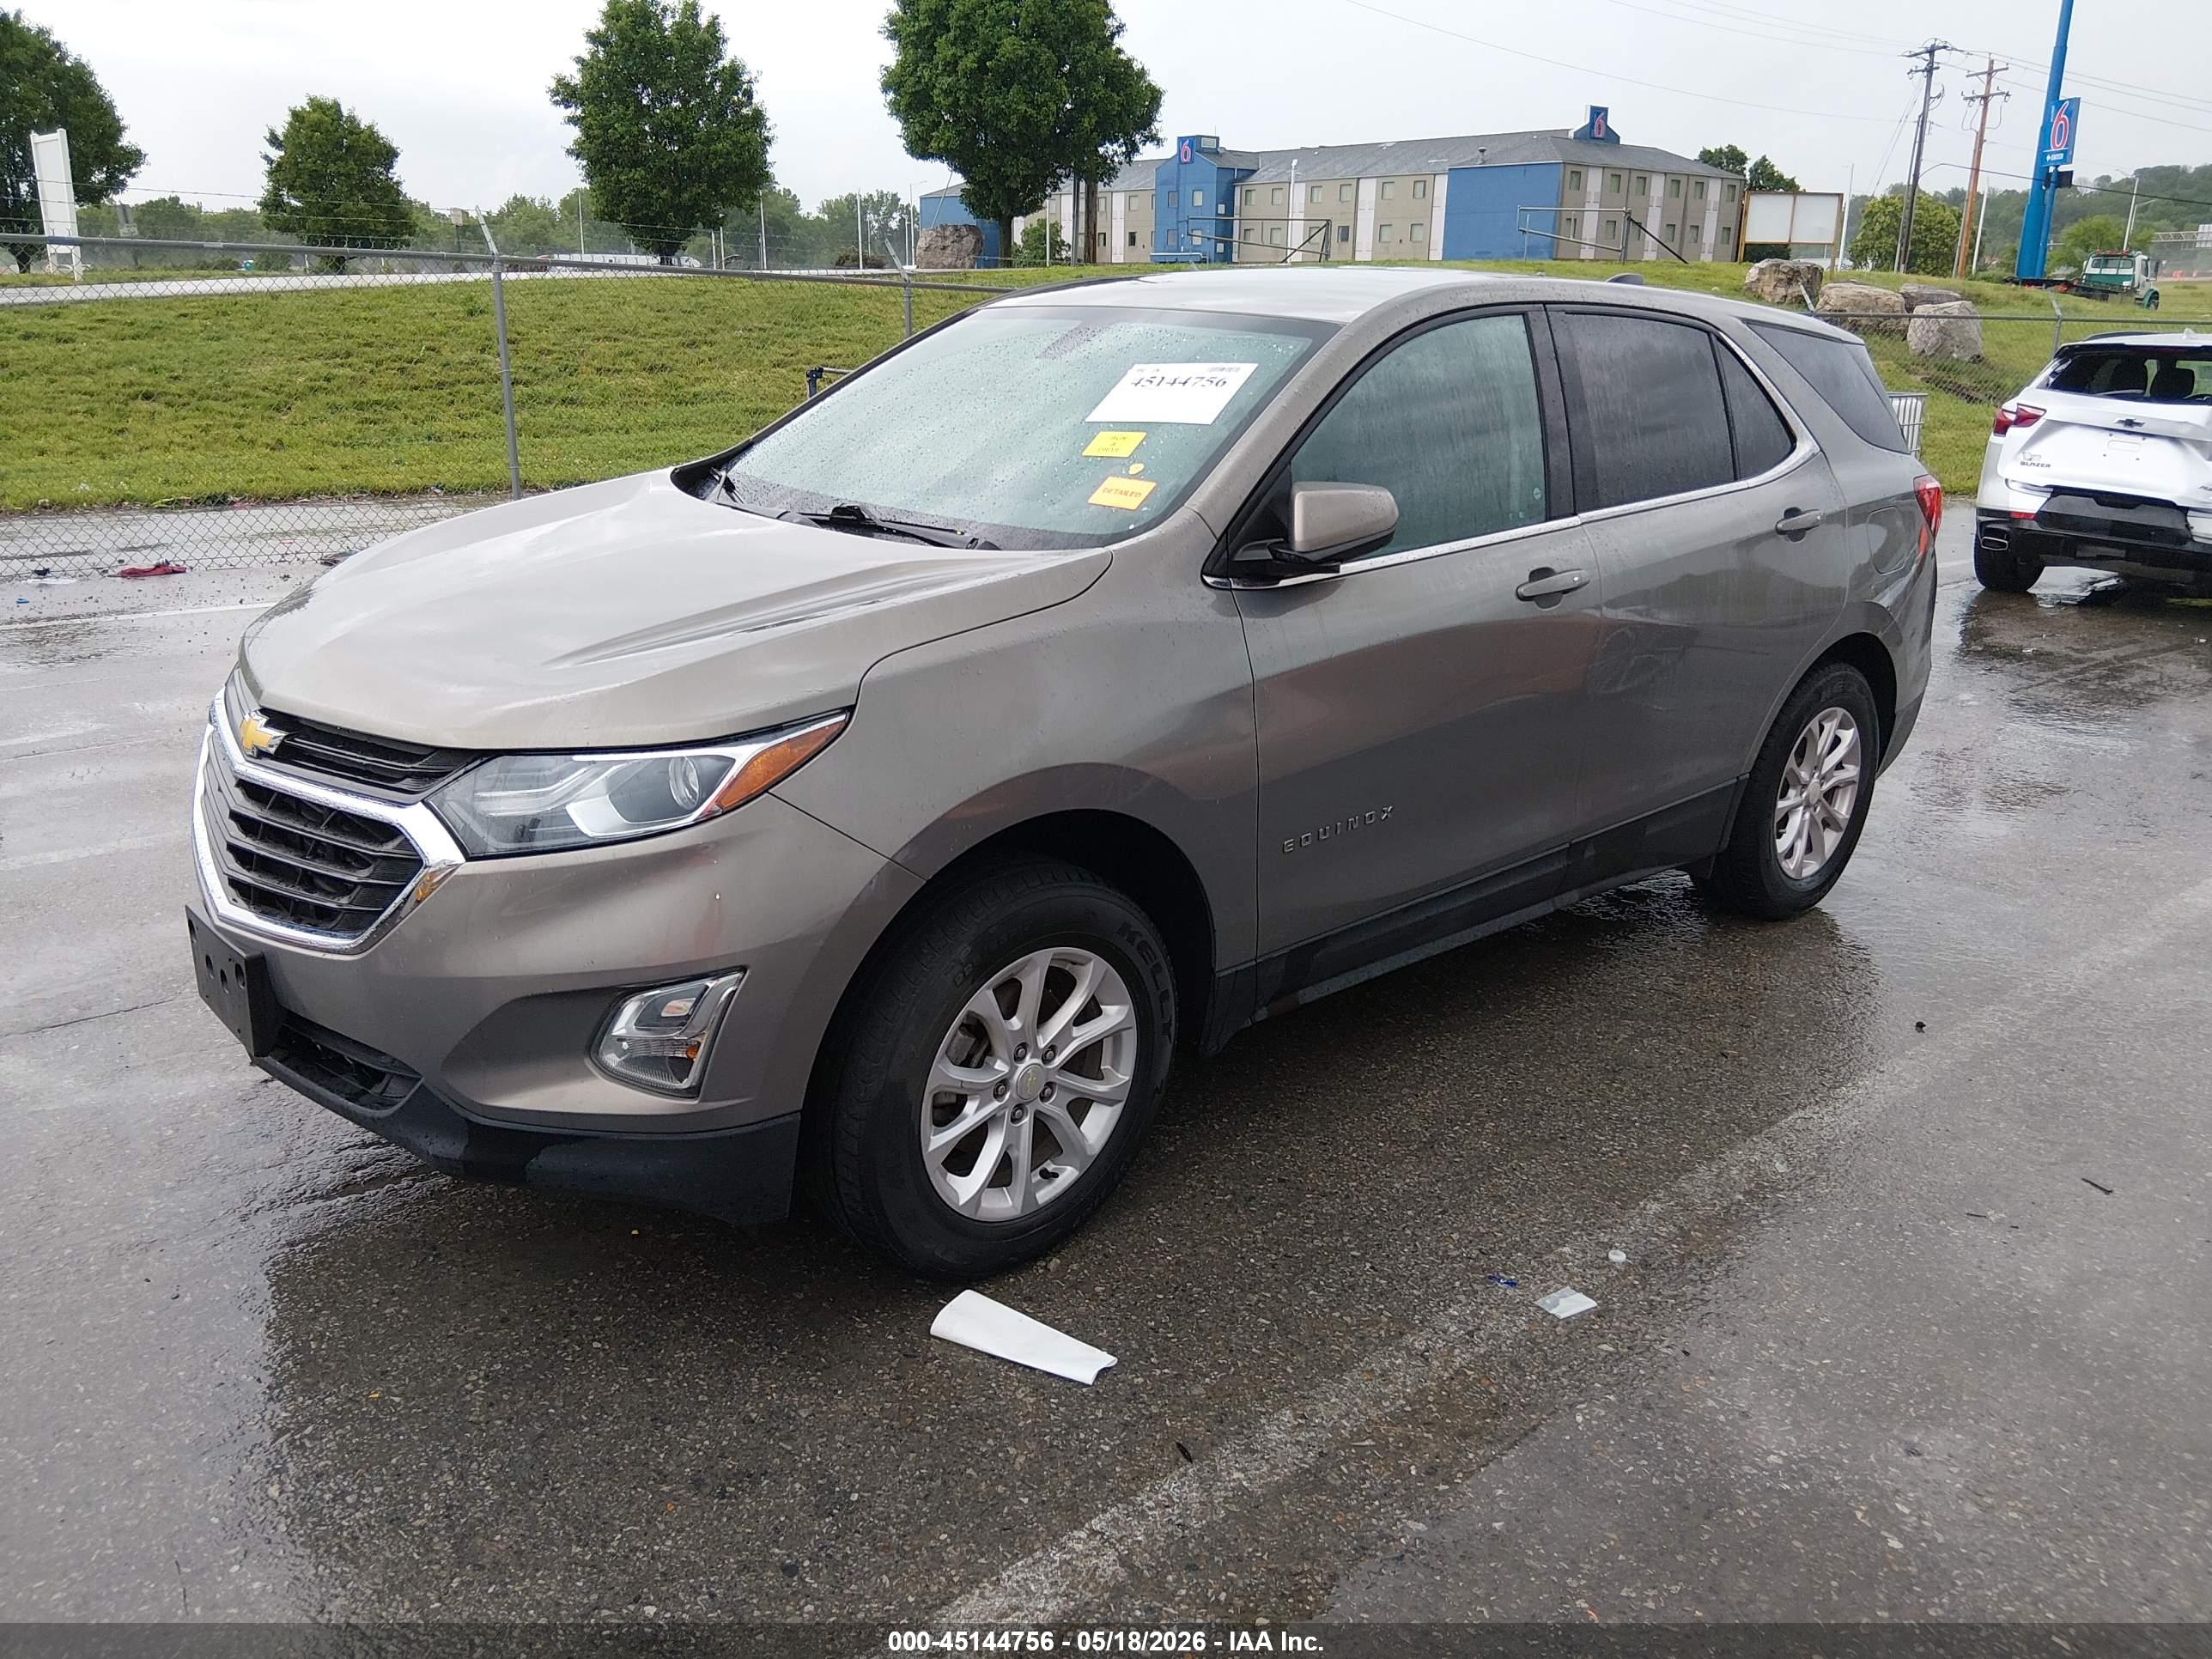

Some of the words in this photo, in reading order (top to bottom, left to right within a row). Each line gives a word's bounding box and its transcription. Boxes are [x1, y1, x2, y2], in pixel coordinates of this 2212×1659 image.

[1594, 112, 1605, 137] 6
[2051, 100, 2069, 150] 6
[1180, 139, 1192, 164] 6
[1131, 375, 1227, 387] 45144756
[1103, 487, 1142, 497] DETAILED
[1283, 805, 1393, 853] EQUINOX
